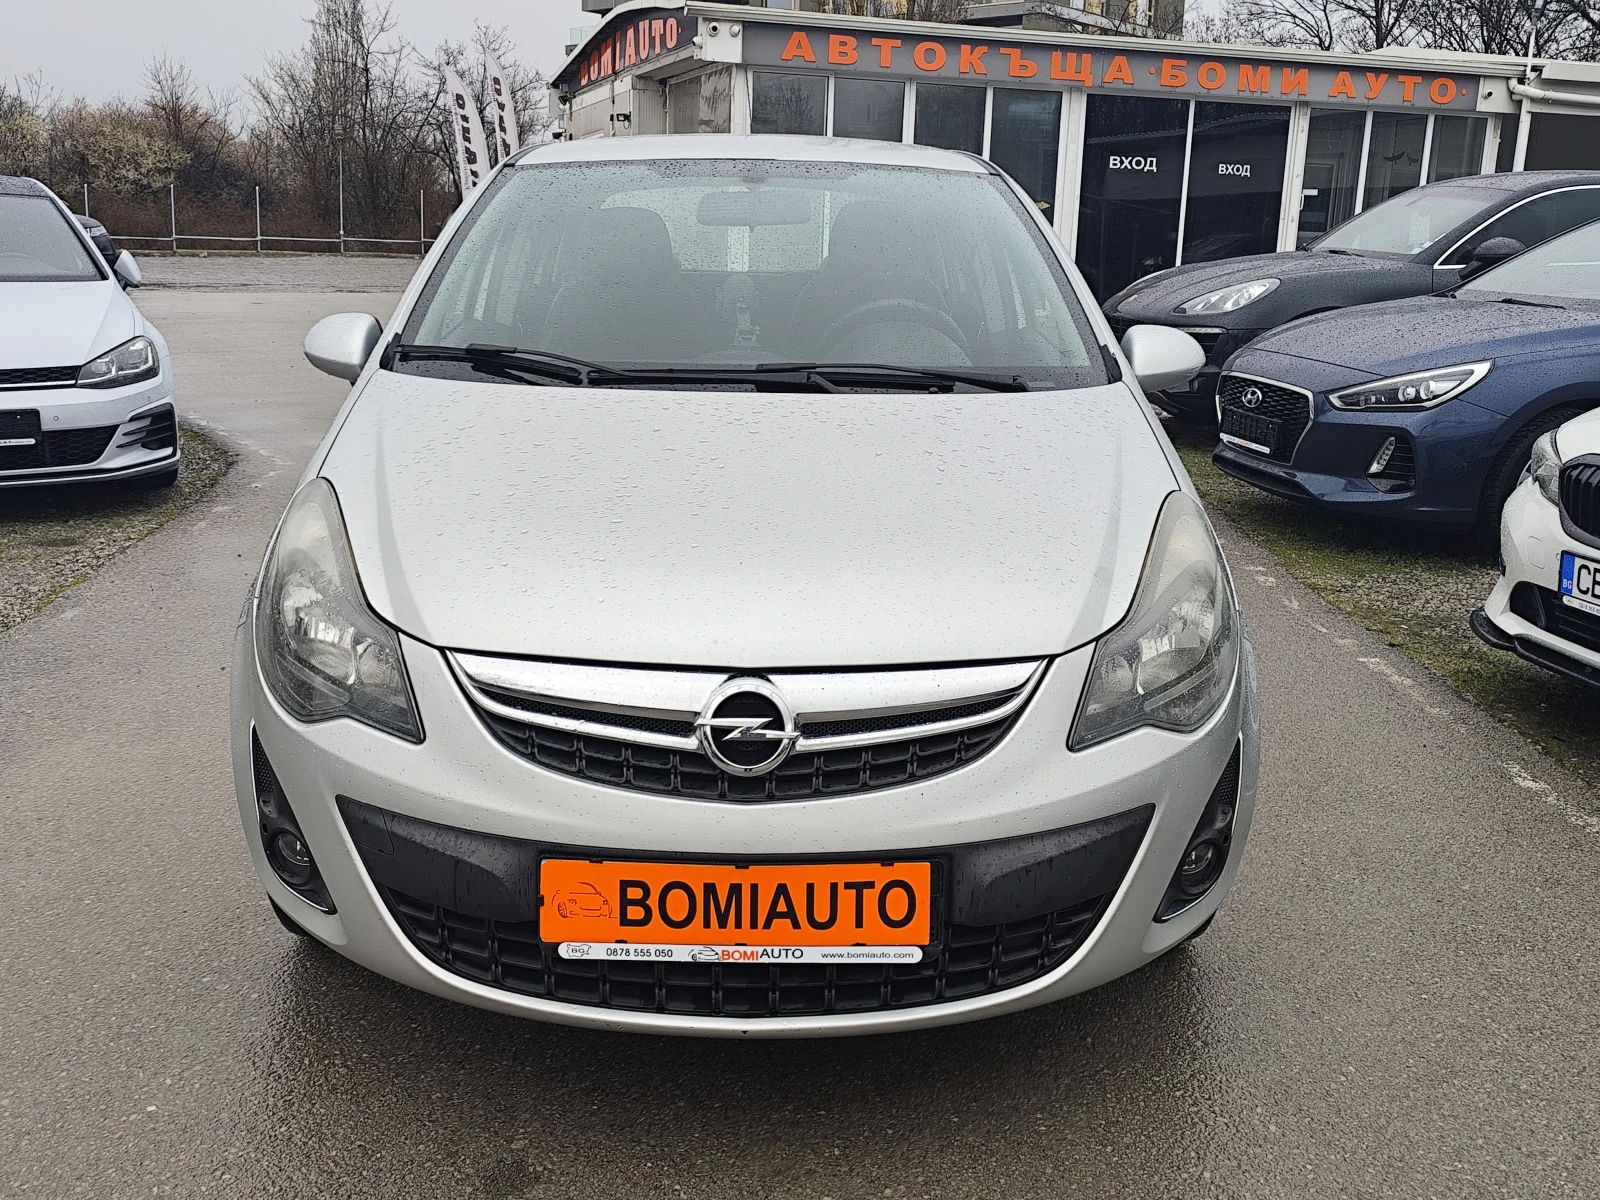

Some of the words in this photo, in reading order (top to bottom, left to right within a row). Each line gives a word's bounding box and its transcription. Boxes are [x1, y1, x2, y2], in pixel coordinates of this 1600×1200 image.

[781, 30, 1134, 89] АВТОКЪЩА
[1109, 155, 1157, 172] ВХОД
[1218, 163, 1251, 178] ВХОД
[1562, 578, 1573, 590] BG
[618, 878, 917, 931] BOMIAUTO
[606, 947, 631, 957] 0878
[633, 948, 652, 958] 555
[654, 948, 674, 958] 050
[820, 951, 915, 959] www.bomiauto.com
